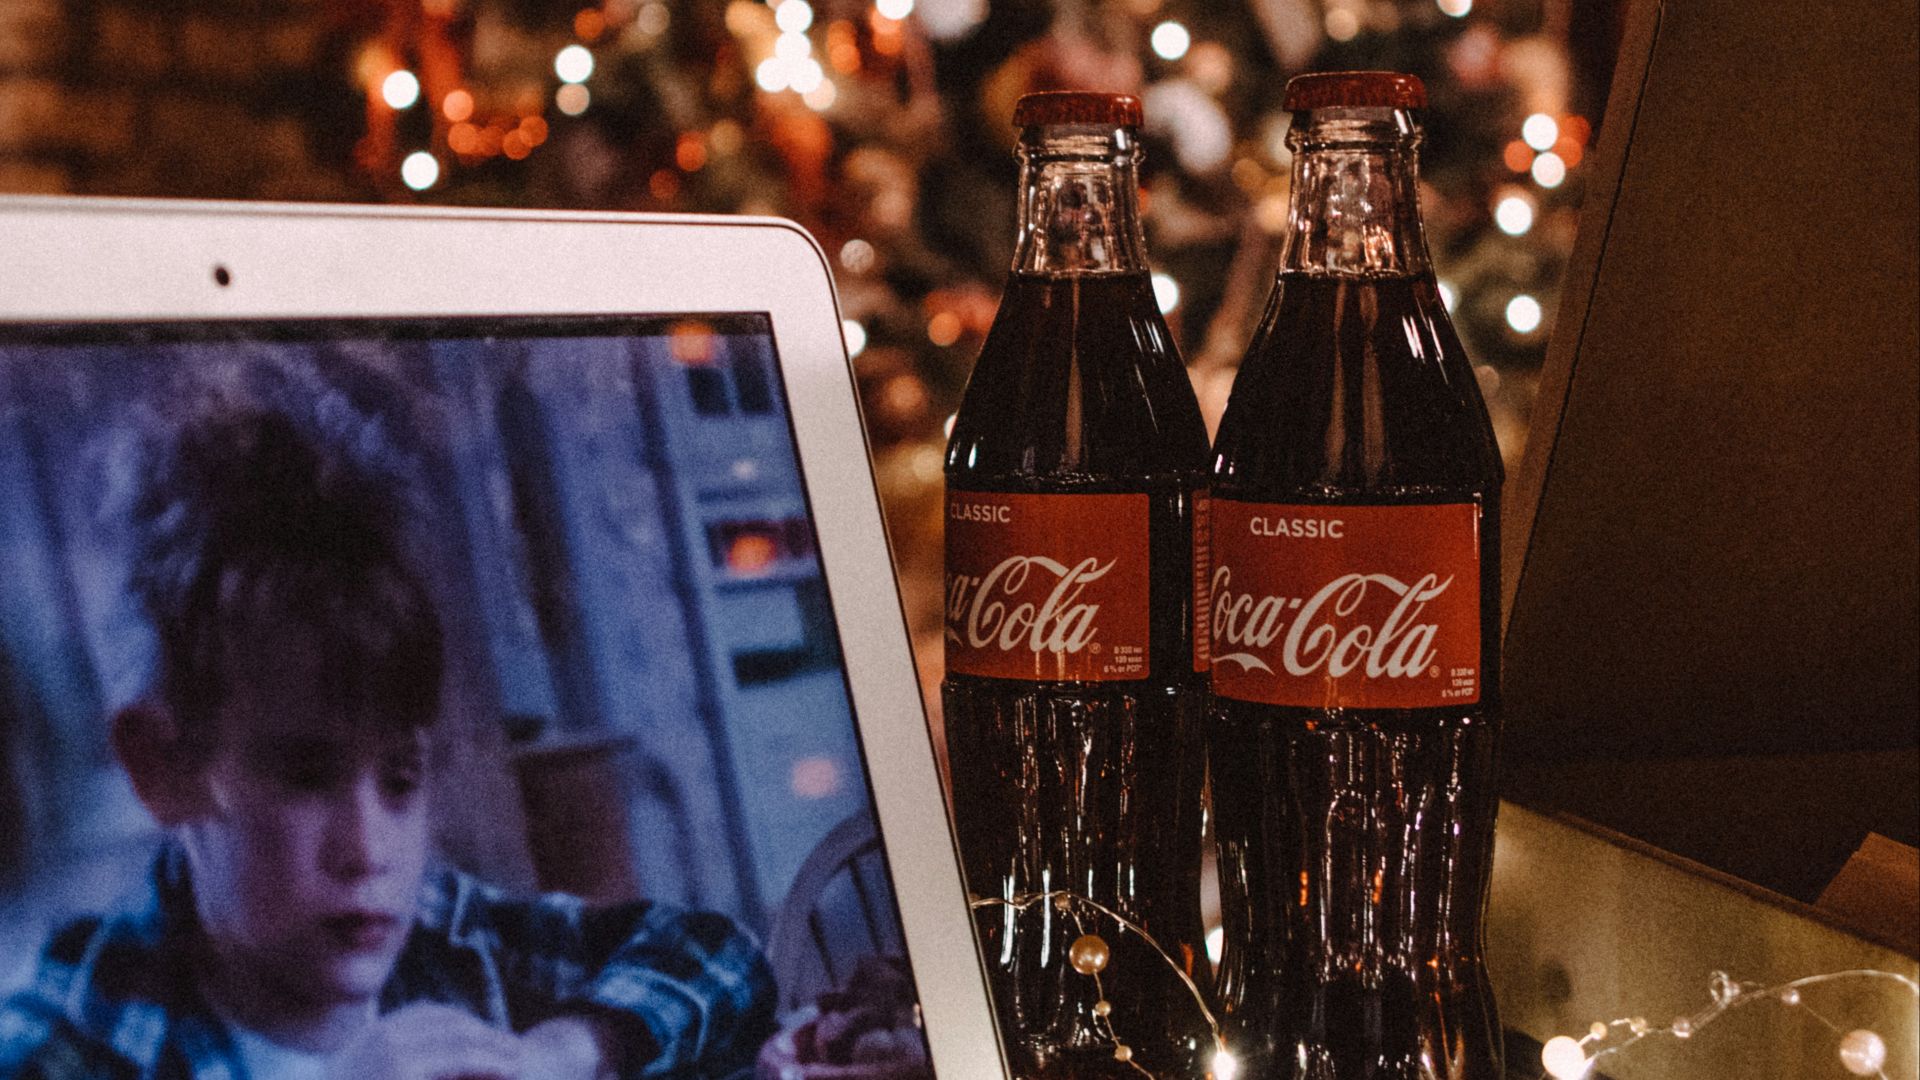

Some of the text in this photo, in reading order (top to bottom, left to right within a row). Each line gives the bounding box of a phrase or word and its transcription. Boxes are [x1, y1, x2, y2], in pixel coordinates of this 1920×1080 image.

[951, 503, 1011, 523] CLASSIC
[1250, 517, 1345, 538] CLASSIC
[947, 555, 1119, 654] a-Cola
[1210, 565, 1455, 678] Coca-Cola
